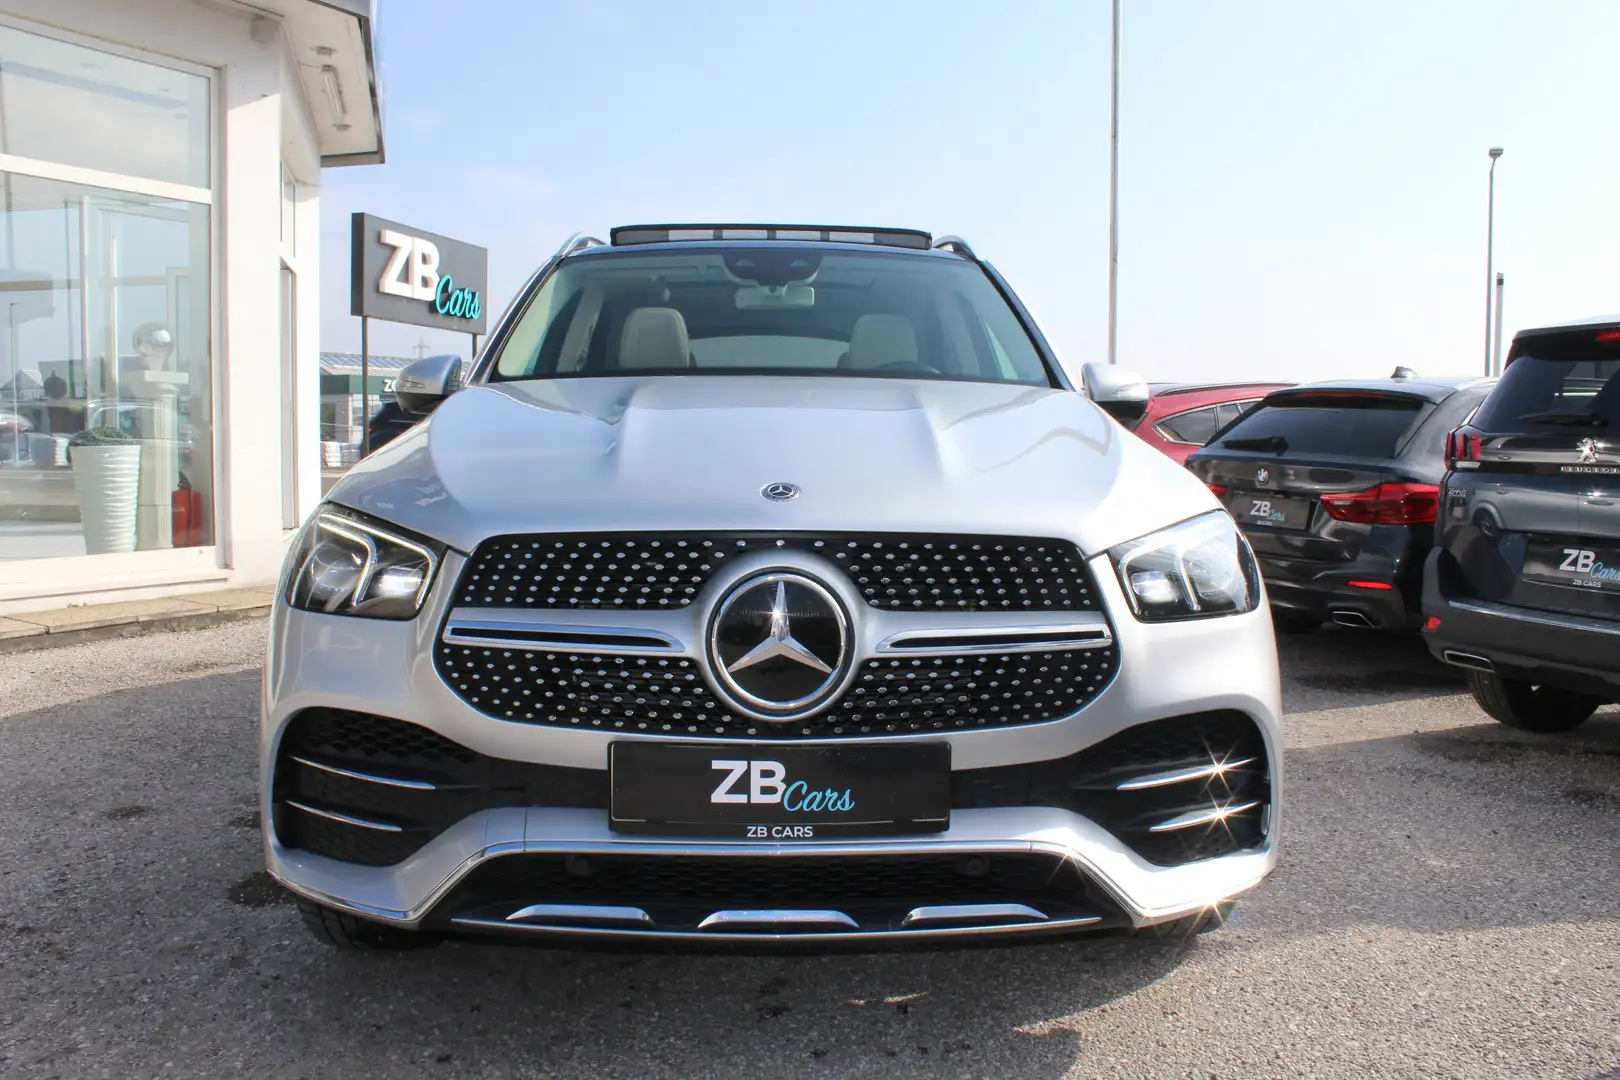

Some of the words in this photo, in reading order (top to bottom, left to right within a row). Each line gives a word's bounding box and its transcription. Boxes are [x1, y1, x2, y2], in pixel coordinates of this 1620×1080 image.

[379, 229, 440, 301] ZB
[435, 274, 480, 320] Cars
[1250, 500, 1271, 516] ZB
[1267, 509, 1285, 521] Cars
[1559, 548, 1596, 573] ZB
[1583, 580, 1602, 588] CARS
[710, 760, 787, 804] ZB
[783, 780, 855, 812] Cars
[746, 826, 768, 838] ZB
[771, 826, 814, 838] CARS
